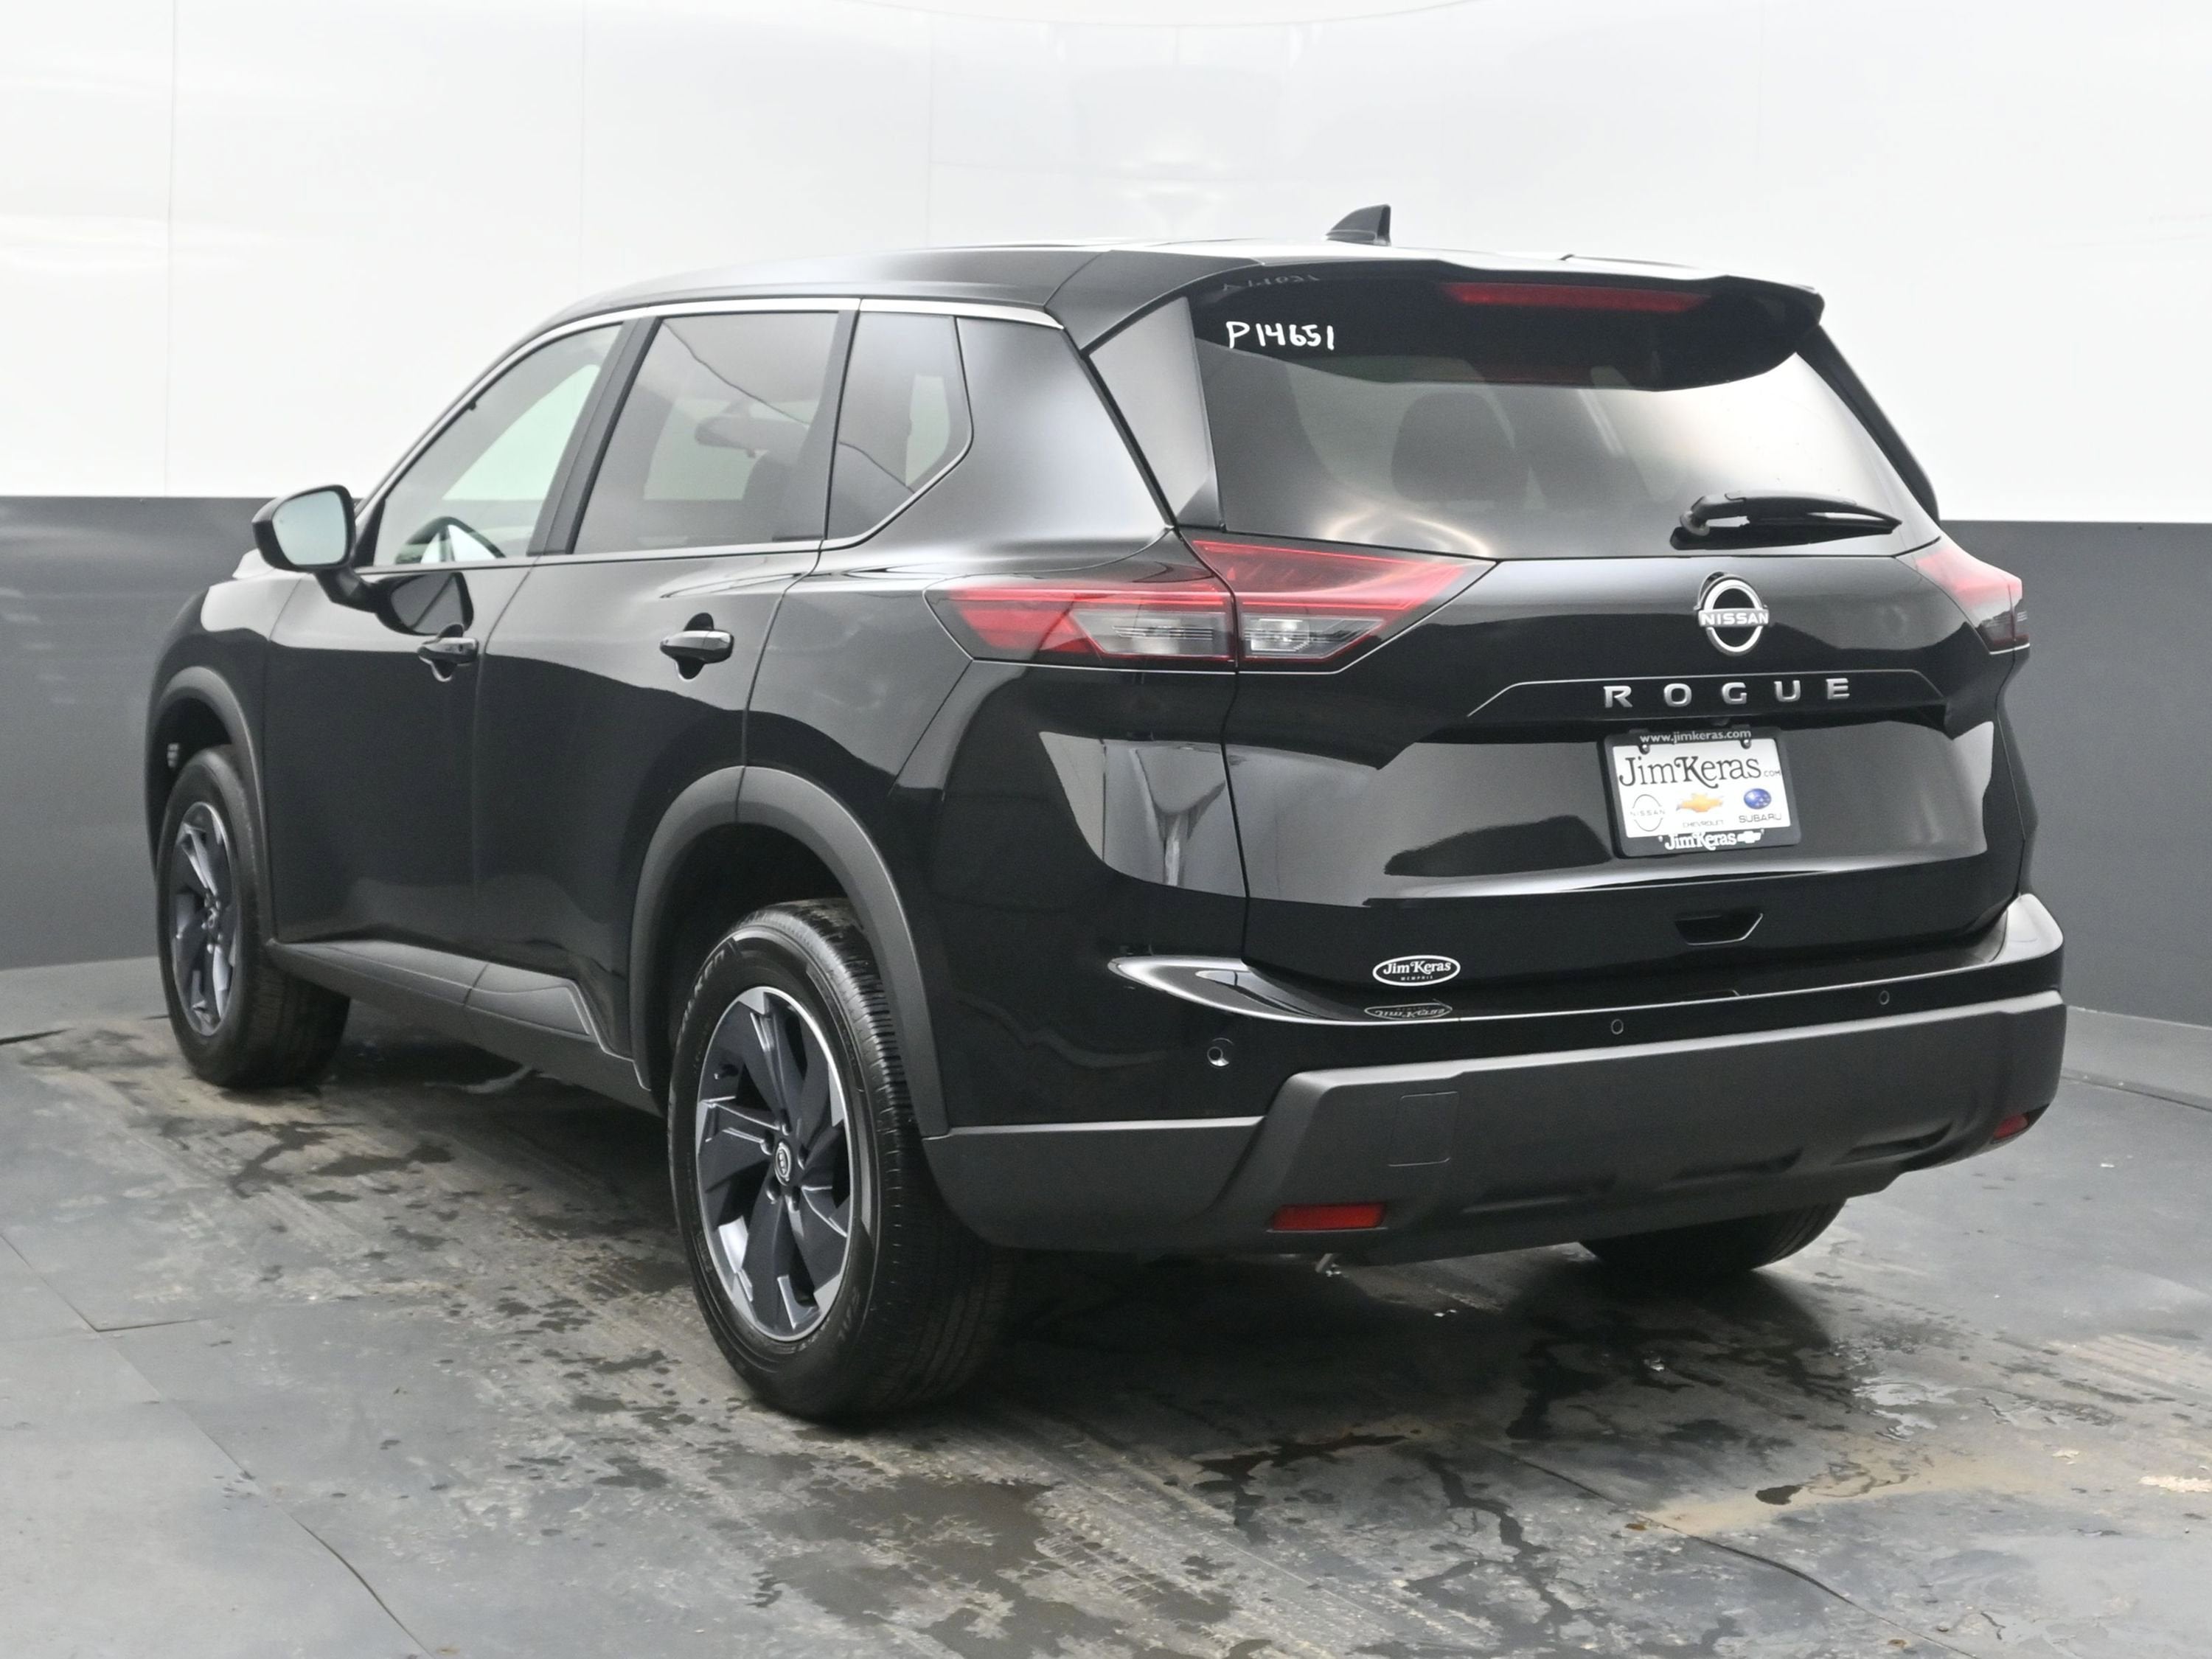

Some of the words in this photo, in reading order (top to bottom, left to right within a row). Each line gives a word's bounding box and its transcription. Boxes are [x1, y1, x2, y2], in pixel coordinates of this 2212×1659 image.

[1225, 321, 1335, 351] P14651
[1700, 612, 1769, 626] NISSAN
[1603, 677, 1851, 709] ROGUE
[1639, 728, 1752, 745] www.jimkeras.com
[1630, 808, 1666, 817] NISSAN
[1738, 813, 1782, 824] SUBARU
[1682, 819, 1724, 828] CHEVROLET
